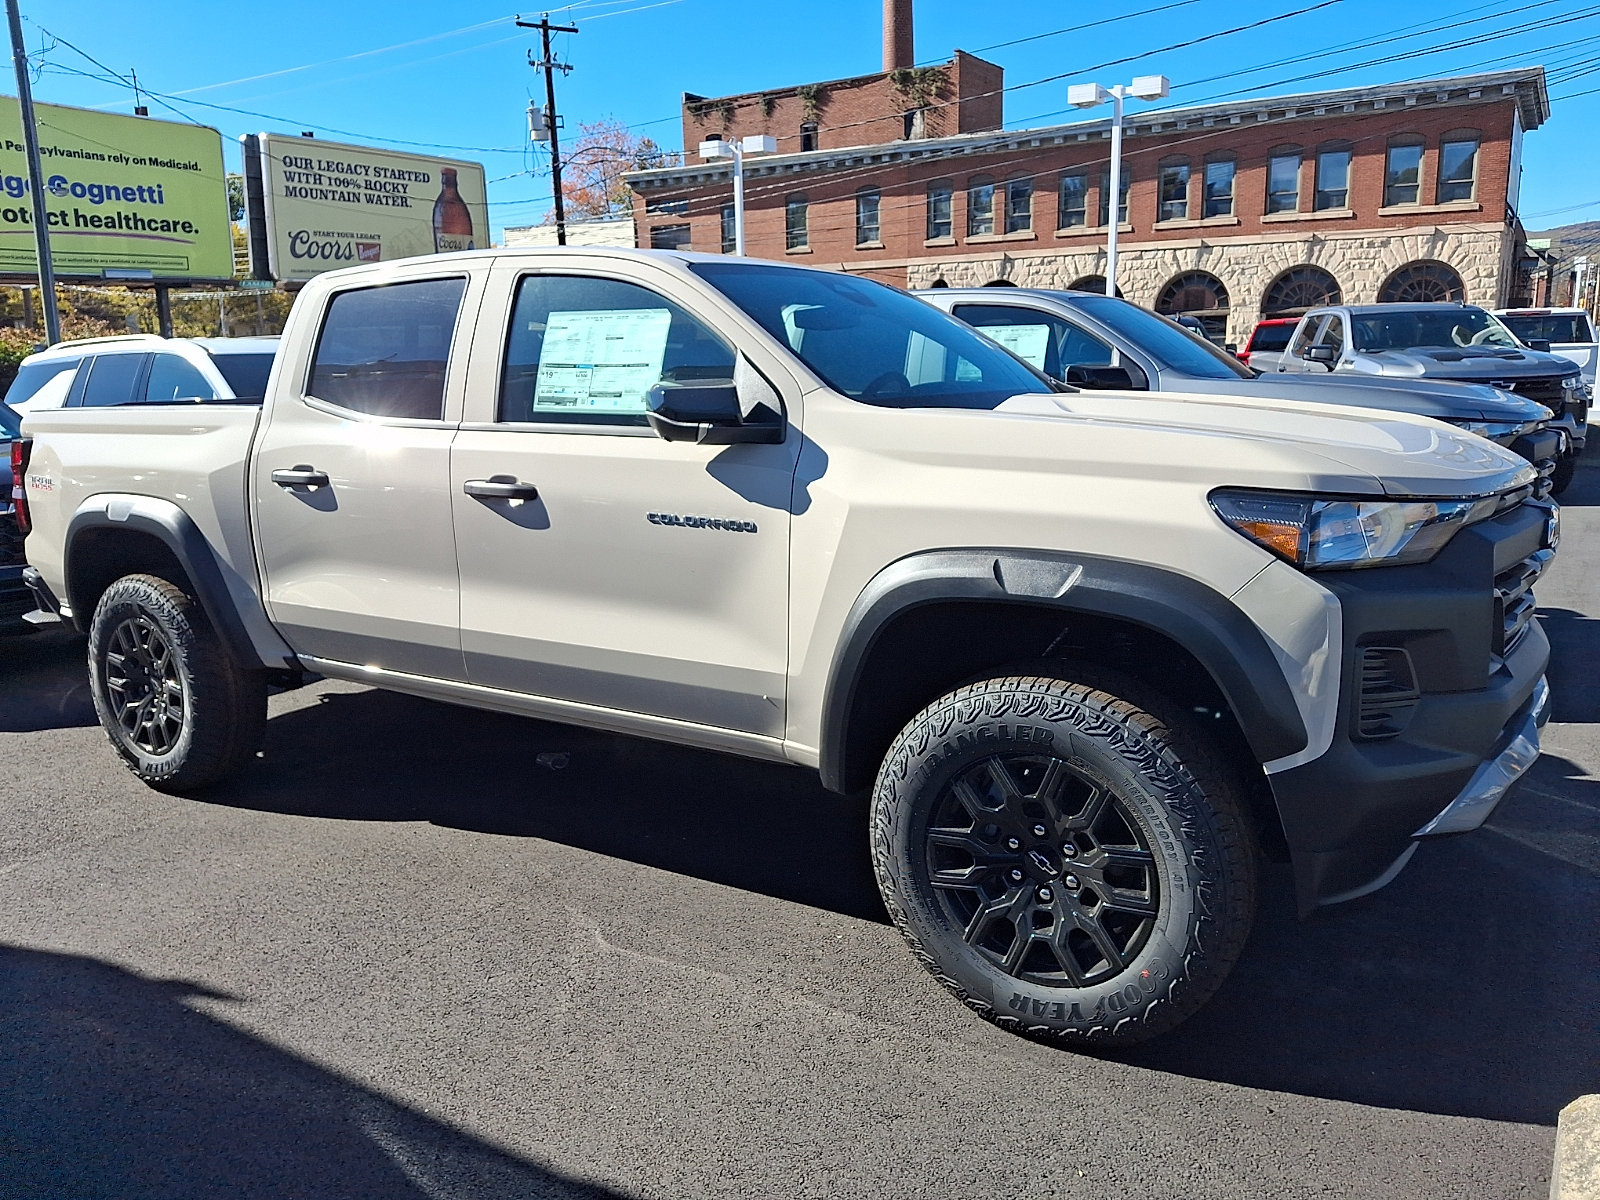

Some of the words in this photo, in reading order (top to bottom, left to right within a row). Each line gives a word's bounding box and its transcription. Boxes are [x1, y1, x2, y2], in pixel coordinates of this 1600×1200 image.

[5, 140, 105, 161] Pesylvanians
[107, 153, 130, 166] rely
[132, 157, 147, 166] on
[149, 157, 202, 172] Medicaid.
[282, 155, 314, 170] OUR
[318, 160, 369, 176] LEGACY
[373, 166, 430, 183] STARTED
[48, 175, 164, 205] Cognetti
[283, 170, 323, 185] WITH
[327, 176, 361, 188] 100%
[364, 180, 409, 194] ROCKY
[284, 185, 361, 203] MOUNTAIN
[364, 193, 413, 208] WATER.
[74, 208, 199, 234] healthcare.
[288, 229, 354, 260] Coors
[313, 230, 335, 238] START
[439, 235, 462, 249] Coors
[646, 511, 758, 533] COLORADO
